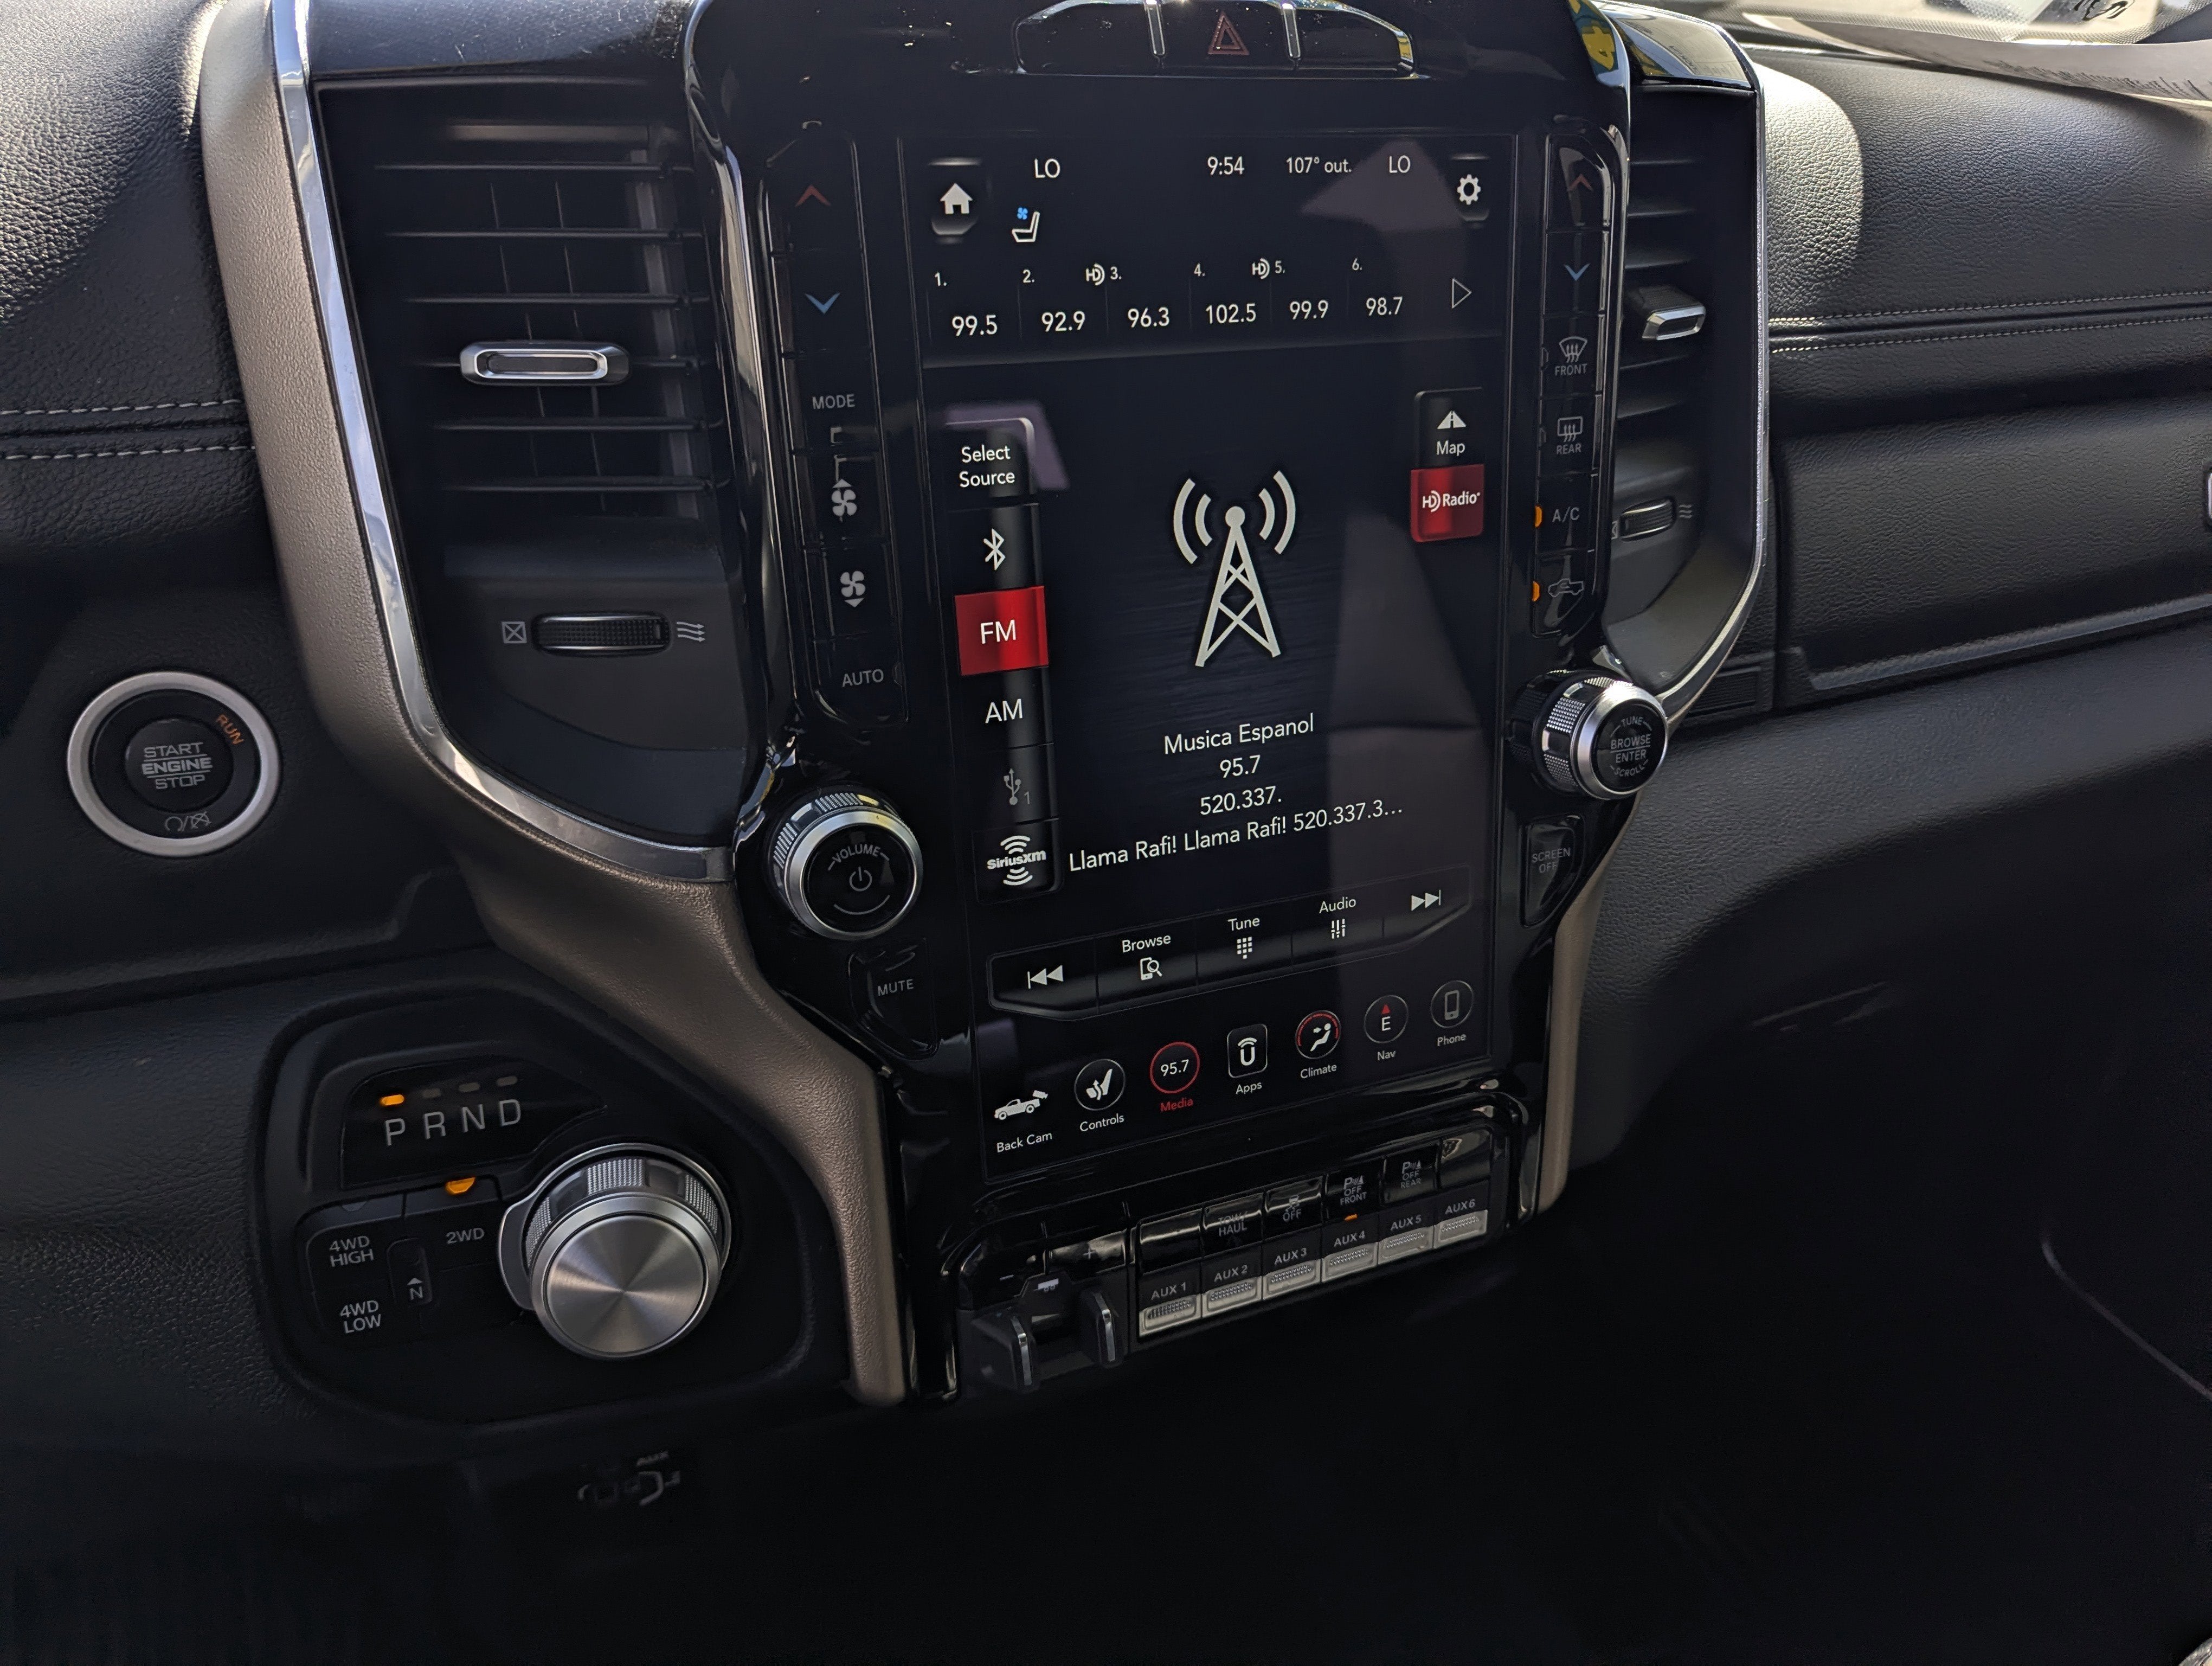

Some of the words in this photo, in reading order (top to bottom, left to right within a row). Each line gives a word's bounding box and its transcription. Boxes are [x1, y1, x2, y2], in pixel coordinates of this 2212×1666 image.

[1034, 158, 1060, 178] LO
[1207, 156, 1245, 175] 9:54
[1286, 156, 1320, 174] 107°
[1324, 159, 1352, 173] out.
[1389, 155, 1411, 174] LO
[1110, 266, 1122, 280] 3.
[1194, 263, 1205, 277] 4.
[1275, 260, 1285, 274] 5.
[1352, 258, 1362, 271] 6.
[934, 272, 947, 286] 1.
[1023, 269, 1035, 283] 2.
[1206, 303, 1256, 324] 102.5
[1289, 299, 1329, 320] 99.9
[1366, 296, 1403, 316] 98.7
[951, 315, 998, 336] 99.5
[1041, 311, 1085, 332] 92.9
[1127, 307, 1170, 328] 96.3
[1555, 364, 1587, 376] FRONT
[812, 394, 856, 409] MODE
[961, 444, 1011, 463] Select
[1436, 440, 1465, 457] Map
[1556, 443, 1582, 454] REAR
[959, 471, 1015, 488] Source
[1552, 506, 1579, 523] A/C
[980, 619, 1017, 644] FM
[842, 669, 884, 688] AUTO
[985, 698, 1023, 723] AM
[217, 714, 244, 745] RUN
[1621, 716, 1643, 727] TUNE
[1165, 729, 1232, 755] Musica
[1239, 712, 1313, 744] Espanol
[1610, 733, 1651, 749] BROWSE
[144, 742, 203, 758] START
[1616, 749, 1647, 764] ENTER
[141, 758, 214, 775] ENGINE
[1219, 754, 1261, 778] 95.7
[1614, 764, 1645, 777] SCROLL
[155, 774, 206, 790] STOP
[1200, 785, 1282, 815] 520.337.
[1069, 849, 1128, 872] Llama
[1136, 835, 1176, 860] Rafi!
[1184, 830, 1240, 851] Llama
[1247, 816, 1286, 840] Rafi!
[1294, 799, 1402, 831] 520.337.3...
[832, 843, 880, 864] VOLUME
[1532, 847, 1571, 863] SCREEN
[1319, 896, 1356, 914] Audio
[1227, 918, 1260, 931] Tune
[1122, 935, 1171, 953] Browse
[877, 978, 914, 996] MUTE
[1381, 1016, 1391, 1031] E
[1437, 1034, 1467, 1047] Phone
[1377, 1050, 1396, 1061] Nav
[1160, 1059, 1189, 1077] 95.7
[1300, 1064, 1337, 1079] Climate
[1236, 1082, 1262, 1094] Apps
[1160, 1097, 1193, 1112] Media
[385, 1118, 406, 1146] P
[423, 1111, 446, 1139] R
[461, 1104, 485, 1132] N
[498, 1099, 521, 1126] D
[1079, 1113, 1124, 1132] Controls
[996, 1140, 1024, 1153] Back
[1026, 1133, 1052, 1145] Cam
[1400, 1177, 1422, 1189] REAR
[1402, 1170, 1419, 1181] OFF
[1340, 1191, 1367, 1206] FRONT
[1343, 1185, 1362, 1196] OFF
[1283, 1208, 1302, 1222] OFF
[1445, 1201, 1467, 1215] AUX
[1468, 1199, 1475, 1208] 6
[1219, 1221, 1247, 1237] HAUL
[1390, 1217, 1413, 1232] AUX
[1415, 1214, 1422, 1224] 5
[329, 1235, 370, 1252] 4WD
[446, 1227, 485, 1245] 2WD
[1334, 1233, 1357, 1247] AUX
[1359, 1230, 1365, 1239] 4
[330, 1248, 374, 1267] HIGH
[1274, 1250, 1298, 1265] AUX
[1300, 1247, 1307, 1257] 3
[1214, 1267, 1239, 1282] AUX
[1241, 1265, 1248, 1274] 2
[409, 1286, 423, 1300] N
[1151, 1285, 1178, 1300] AUX
[1181, 1281, 1186, 1291] 1
[339, 1300, 380, 1318] 4WD
[344, 1314, 382, 1334] LOW
